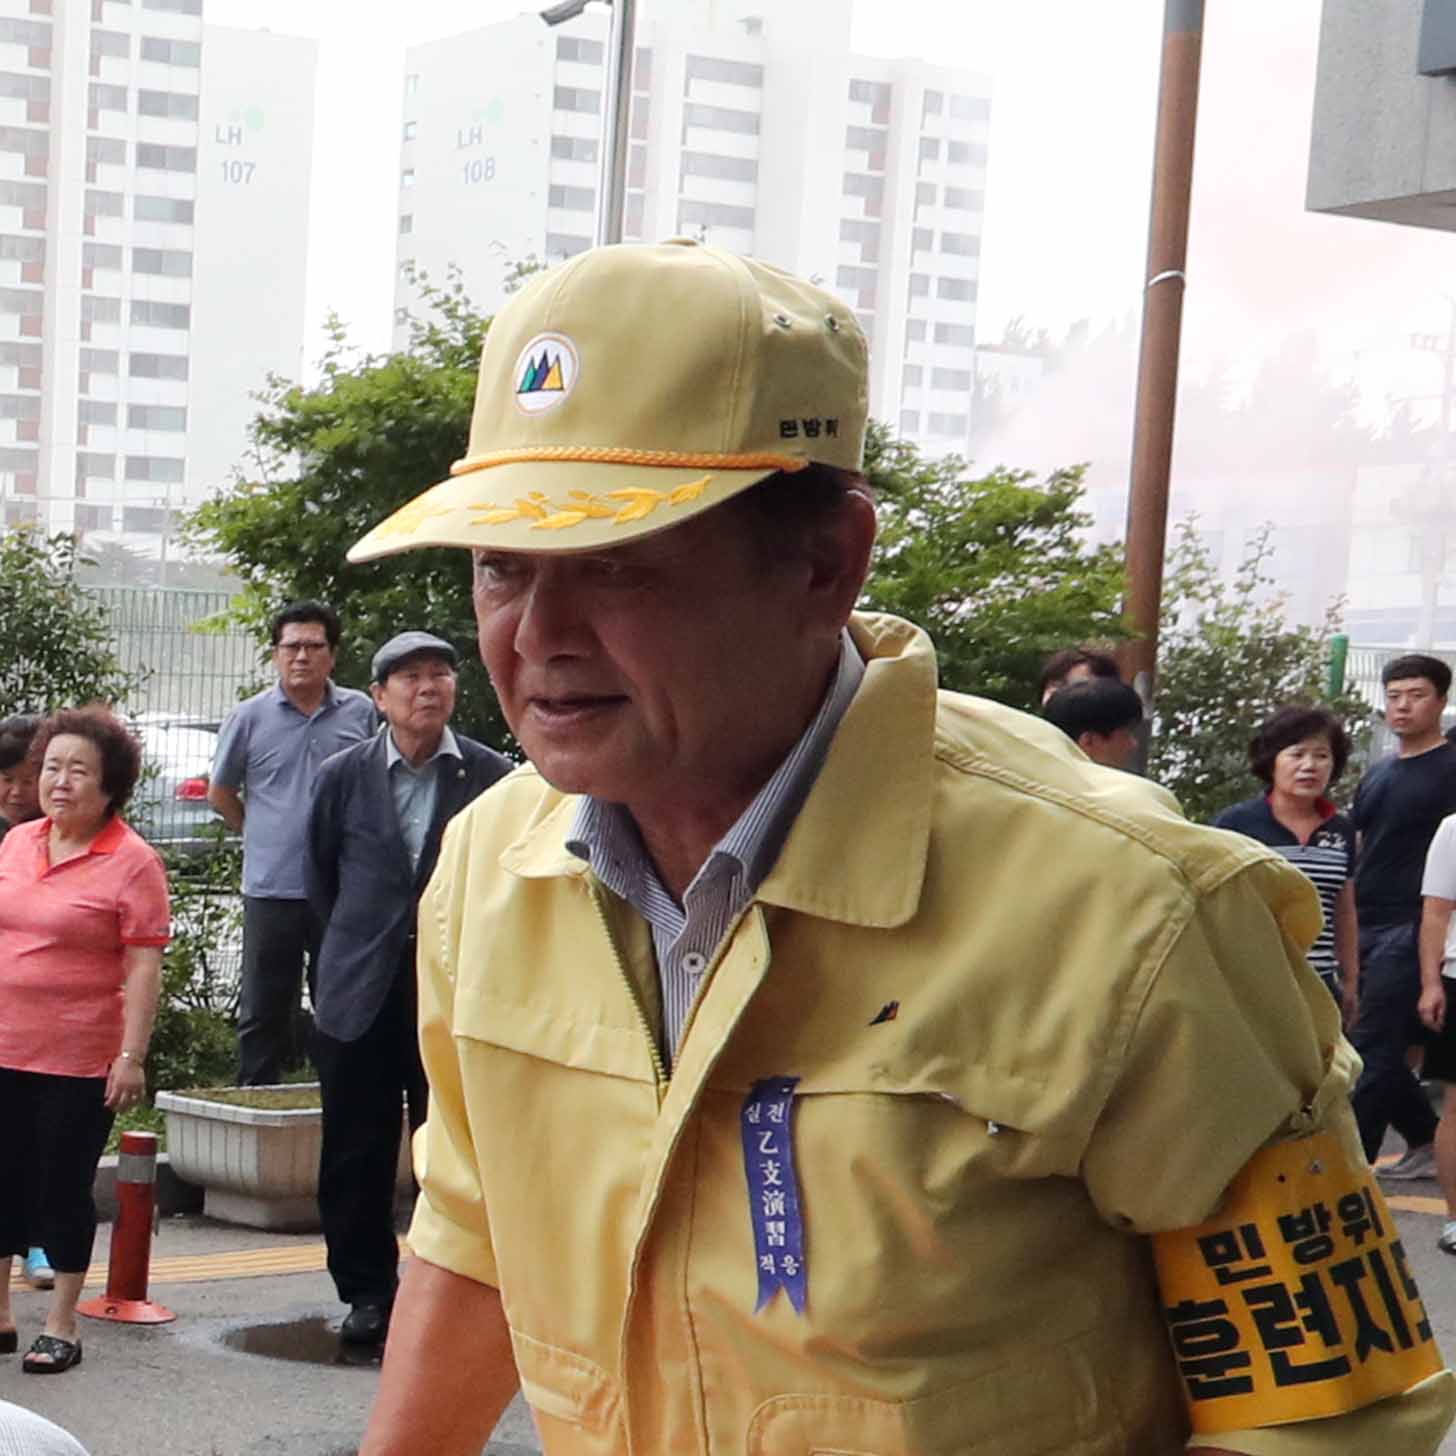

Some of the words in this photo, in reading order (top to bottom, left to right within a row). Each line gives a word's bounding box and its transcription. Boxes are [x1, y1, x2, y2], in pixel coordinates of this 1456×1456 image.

[215, 124, 242, 146] LH
[456, 123, 483, 149] LH
[220, 159, 256, 184] 107
[463, 156, 496, 184] 108
[1196, 1186, 1384, 1286] 민방위
